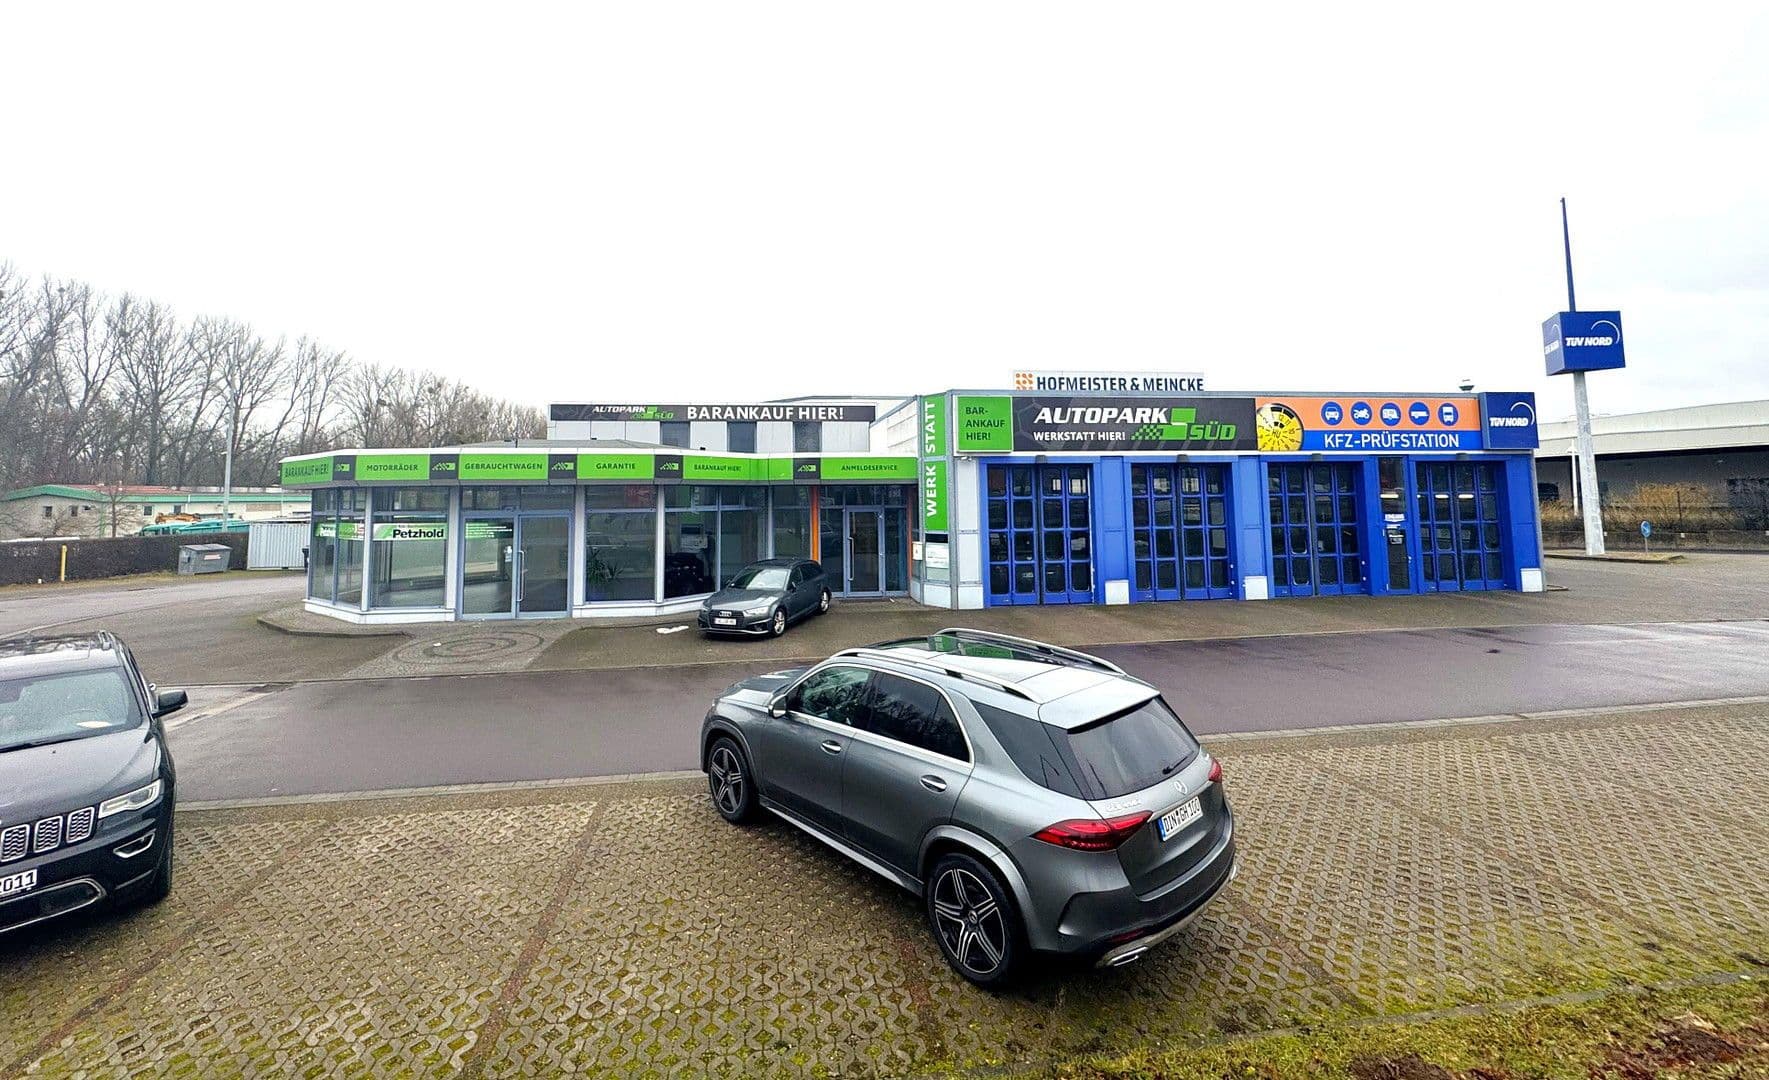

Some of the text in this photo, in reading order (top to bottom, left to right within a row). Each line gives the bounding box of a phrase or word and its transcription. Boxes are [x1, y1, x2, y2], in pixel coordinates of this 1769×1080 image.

[1584, 336, 1613, 347] NORD
[1037, 376, 1204, 391] HOFMEISTER & MEINCKE
[686, 406, 845, 420] BARANKAUF HIER!
[965, 406, 989, 415] BAR-
[925, 401, 936, 454] STATT
[965, 419, 1006, 428] ANKAUF
[1033, 407, 1237, 441] AUTOPARK SÜD
[1505, 417, 1529, 427] NORD
[966, 432, 991, 441] HIER!
[1033, 431, 1126, 441] WERKSTATT HIER!
[1324, 430, 1460, 448] KFZ-PRÜFSTATION
[366, 463, 419, 472] MOTORRÄDER
[464, 462, 543, 470] GEBRAUCHTWAGEN
[595, 462, 636, 470] GARANTIE
[840, 463, 898, 472] ANMELDESERVICE
[926, 465, 937, 517] WERK
[392, 528, 444, 539] Petzhold
[1164, 812, 1178, 832] DIN
[0, 871, 35, 893] 011
